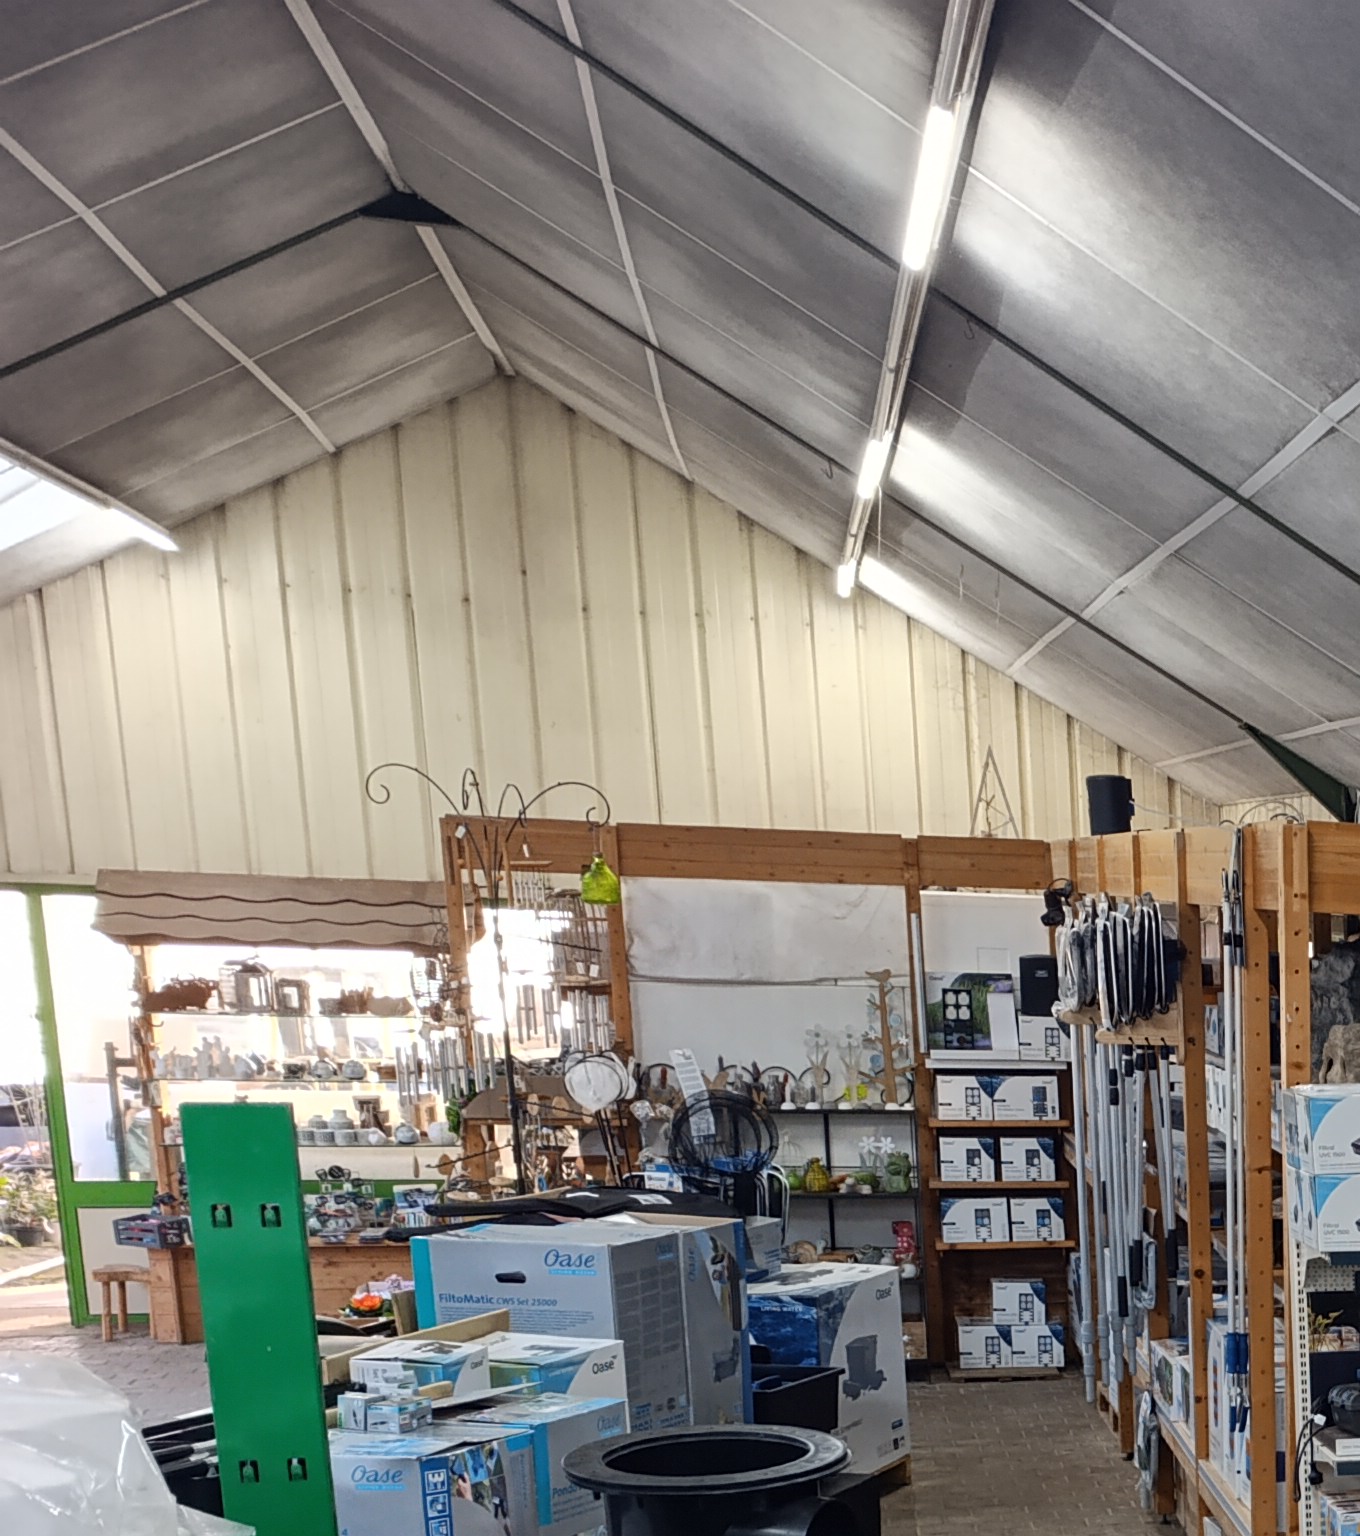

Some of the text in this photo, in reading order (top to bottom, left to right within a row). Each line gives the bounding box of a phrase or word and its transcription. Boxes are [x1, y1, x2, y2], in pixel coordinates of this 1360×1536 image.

[544, 1249, 595, 1268] Oase
[439, 1293, 494, 1306] FiltoMatic
[516, 1298, 529, 1307] Set
[876, 1287, 892, 1300] Oase
[470, 1360, 484, 1370] Oase
[592, 1359, 614, 1376] Oase
[351, 1465, 404, 1484] Oase
